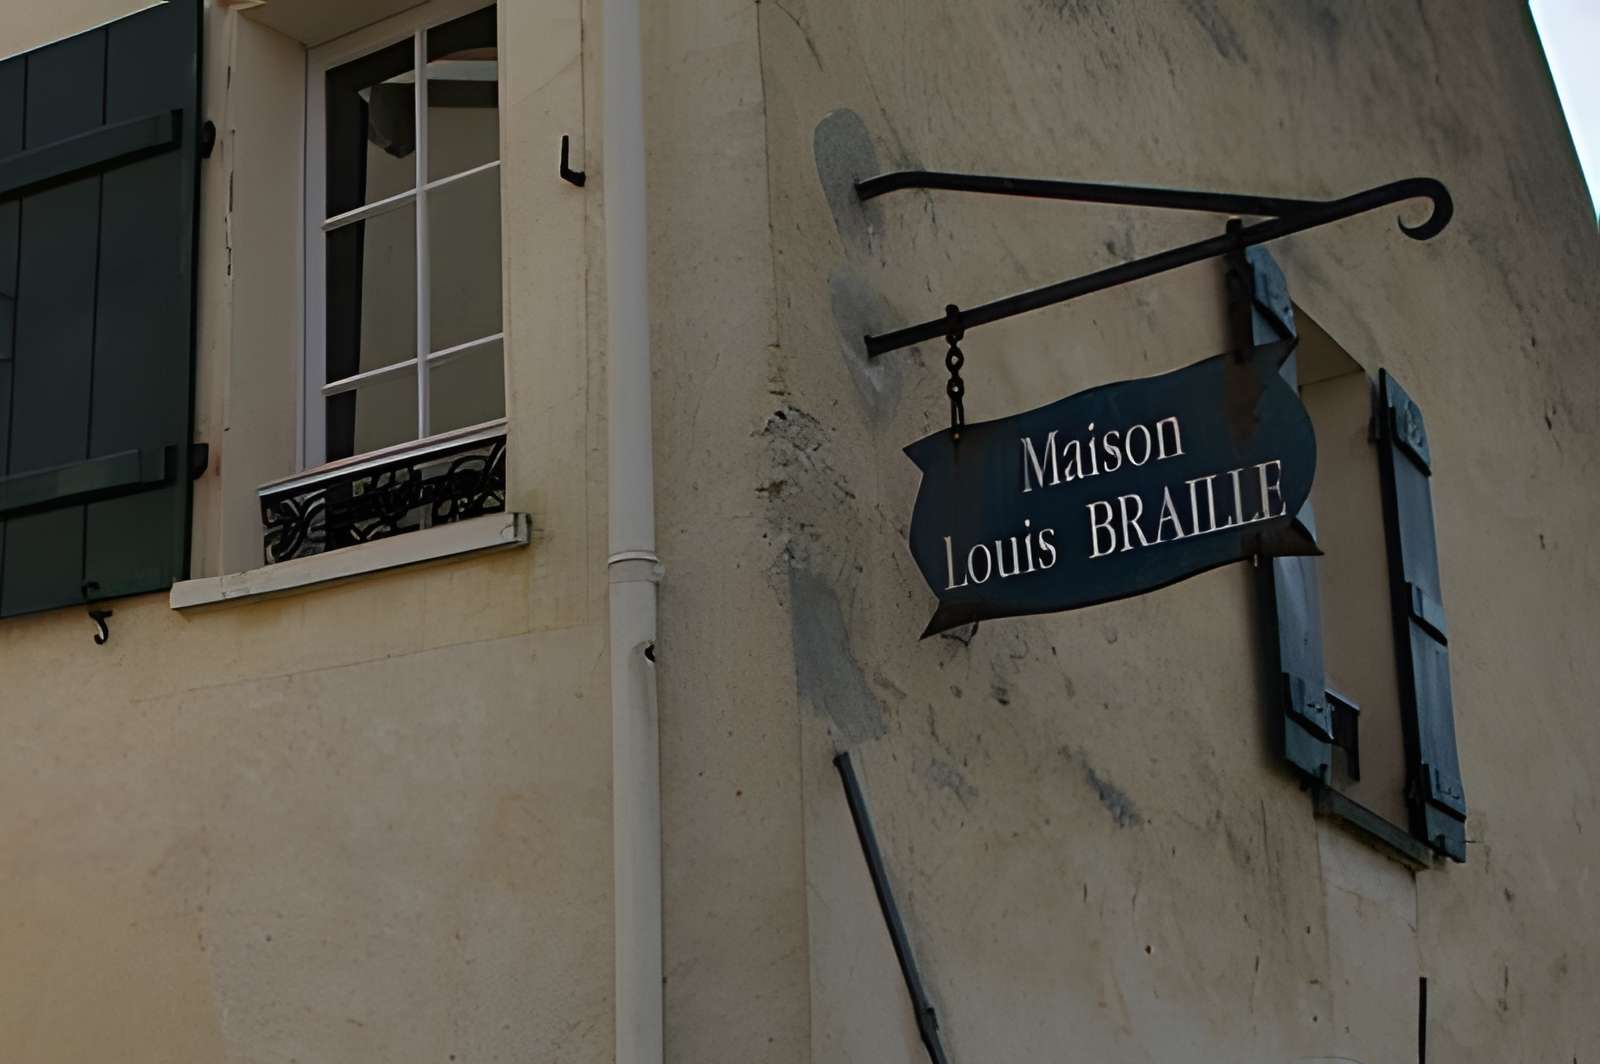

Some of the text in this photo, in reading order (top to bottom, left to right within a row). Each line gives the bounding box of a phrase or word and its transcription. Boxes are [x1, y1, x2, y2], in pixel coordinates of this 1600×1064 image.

[1021, 416, 1186, 491] Maison
[945, 459, 1287, 590] Louis BRAILLE
